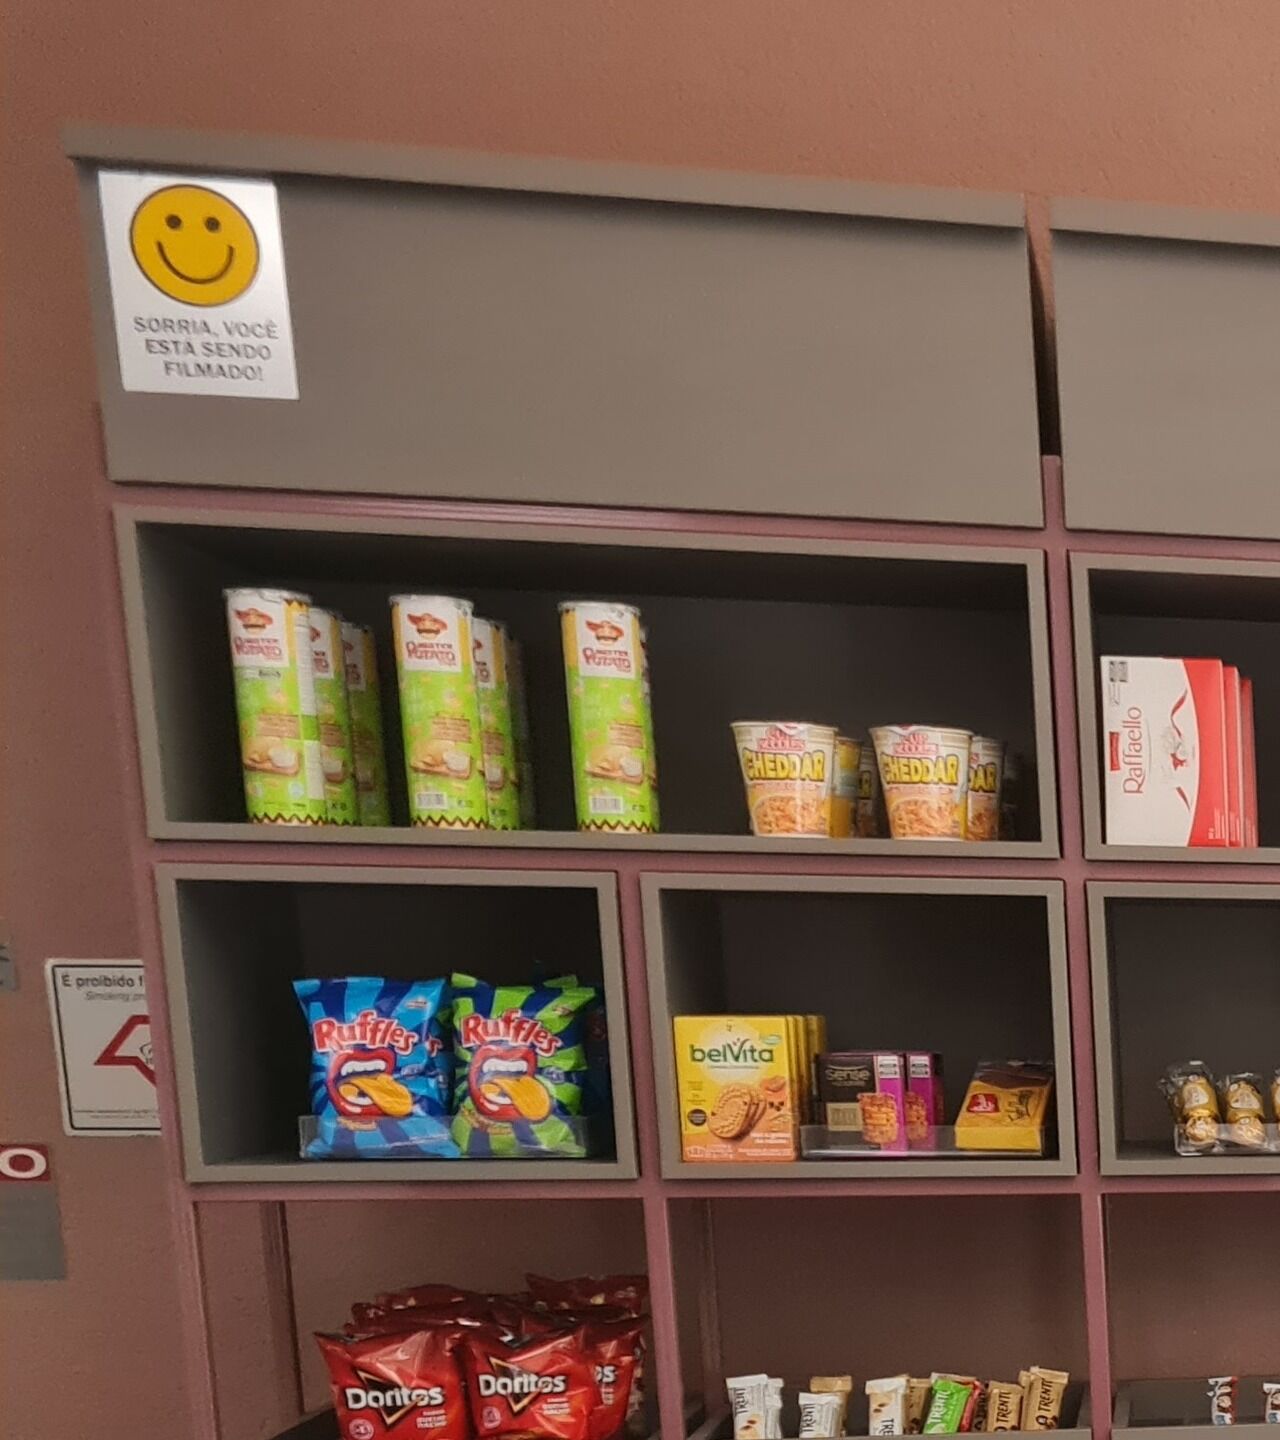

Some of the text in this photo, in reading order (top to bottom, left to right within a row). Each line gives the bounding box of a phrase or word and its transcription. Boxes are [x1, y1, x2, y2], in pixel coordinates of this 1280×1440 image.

[134, 316, 279, 339] SORRIA, VOCÊ
[202, 342, 271, 360] SENDO
[164, 361, 263, 381] FILMADO!
[1122, 706, 1144, 795] Raffaello
[742, 748, 825, 781] CHEDDAR
[881, 753, 959, 785] CHEDDAR
[312, 1009, 418, 1056] Ruffles
[461, 1009, 561, 1057] Ruffles
[690, 1038, 773, 1064] belVita
[344, 1386, 445, 1410] Doritos
[478, 1373, 566, 1397] Doritos
